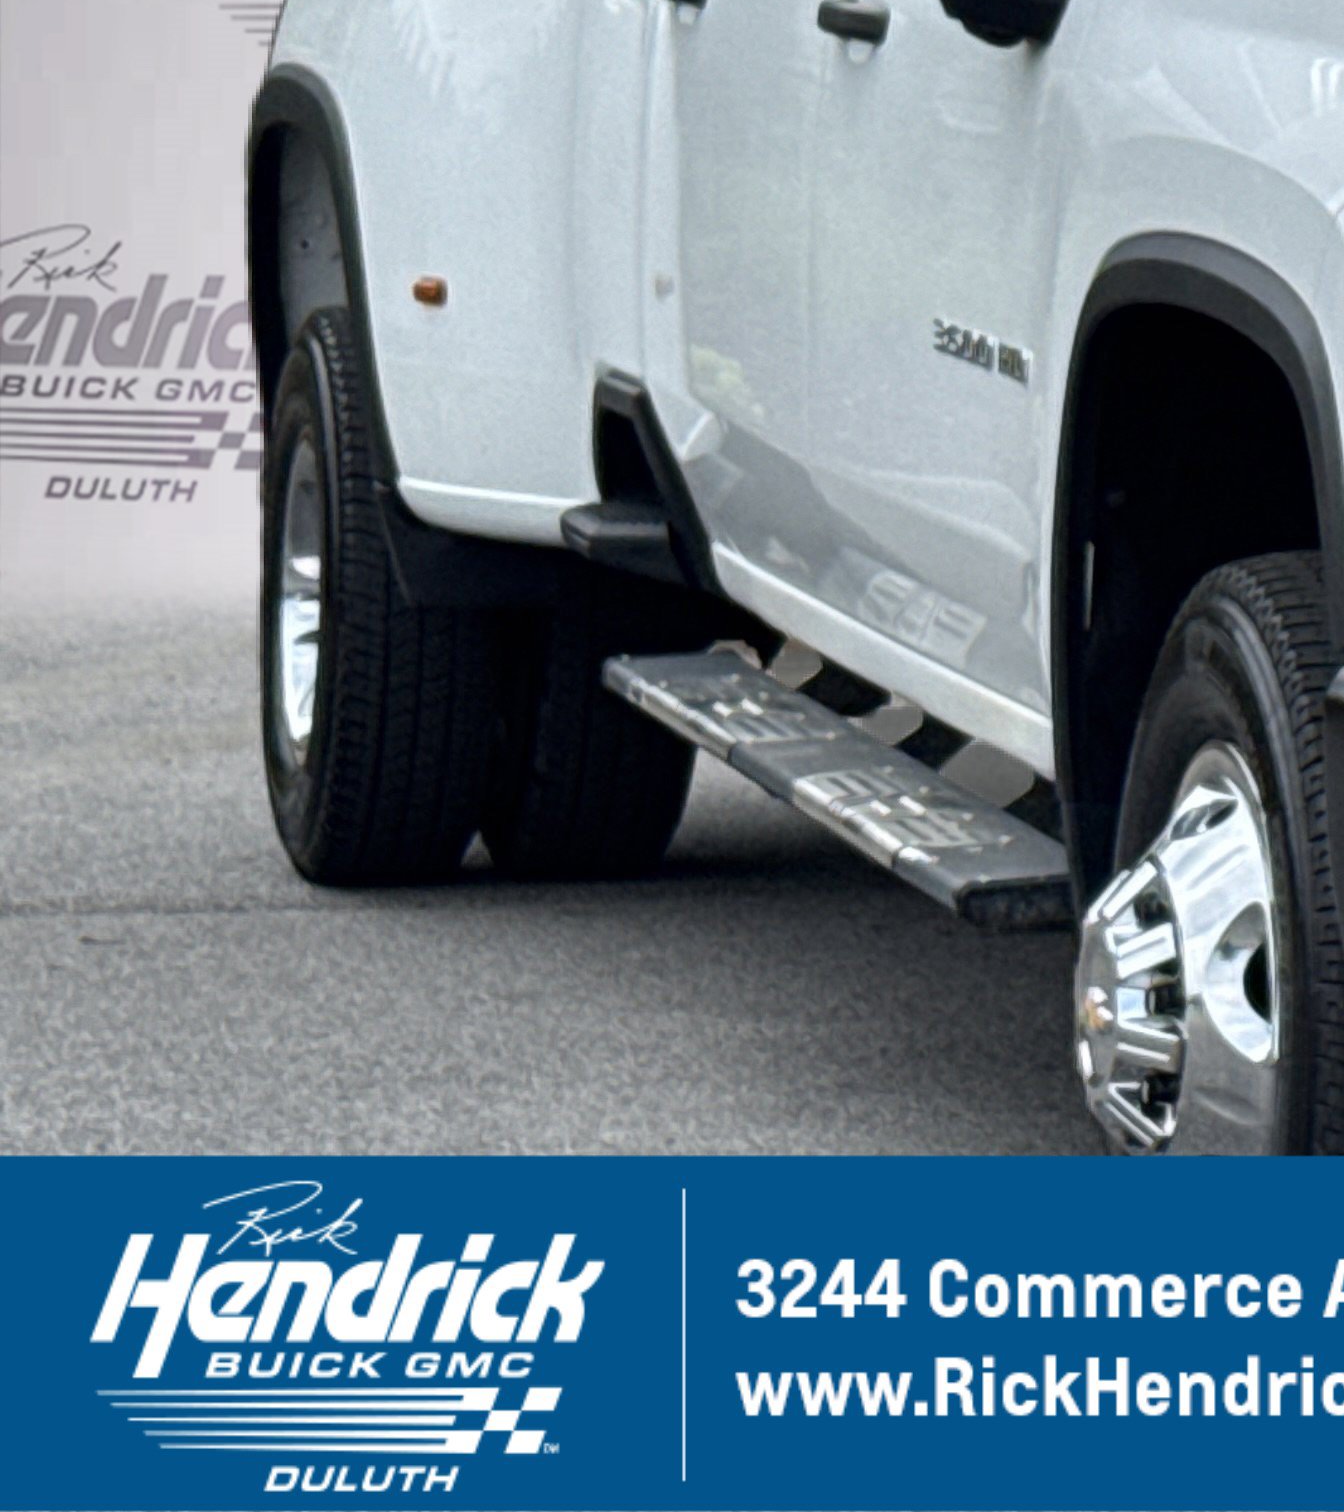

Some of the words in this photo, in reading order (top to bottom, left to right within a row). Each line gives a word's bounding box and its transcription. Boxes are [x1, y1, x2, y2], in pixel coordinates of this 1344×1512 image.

[0, 273, 256, 371] endric
[0, 374, 140, 401] BUICK
[155, 379, 256, 404] GMC
[44, 476, 198, 503] DULUTH
